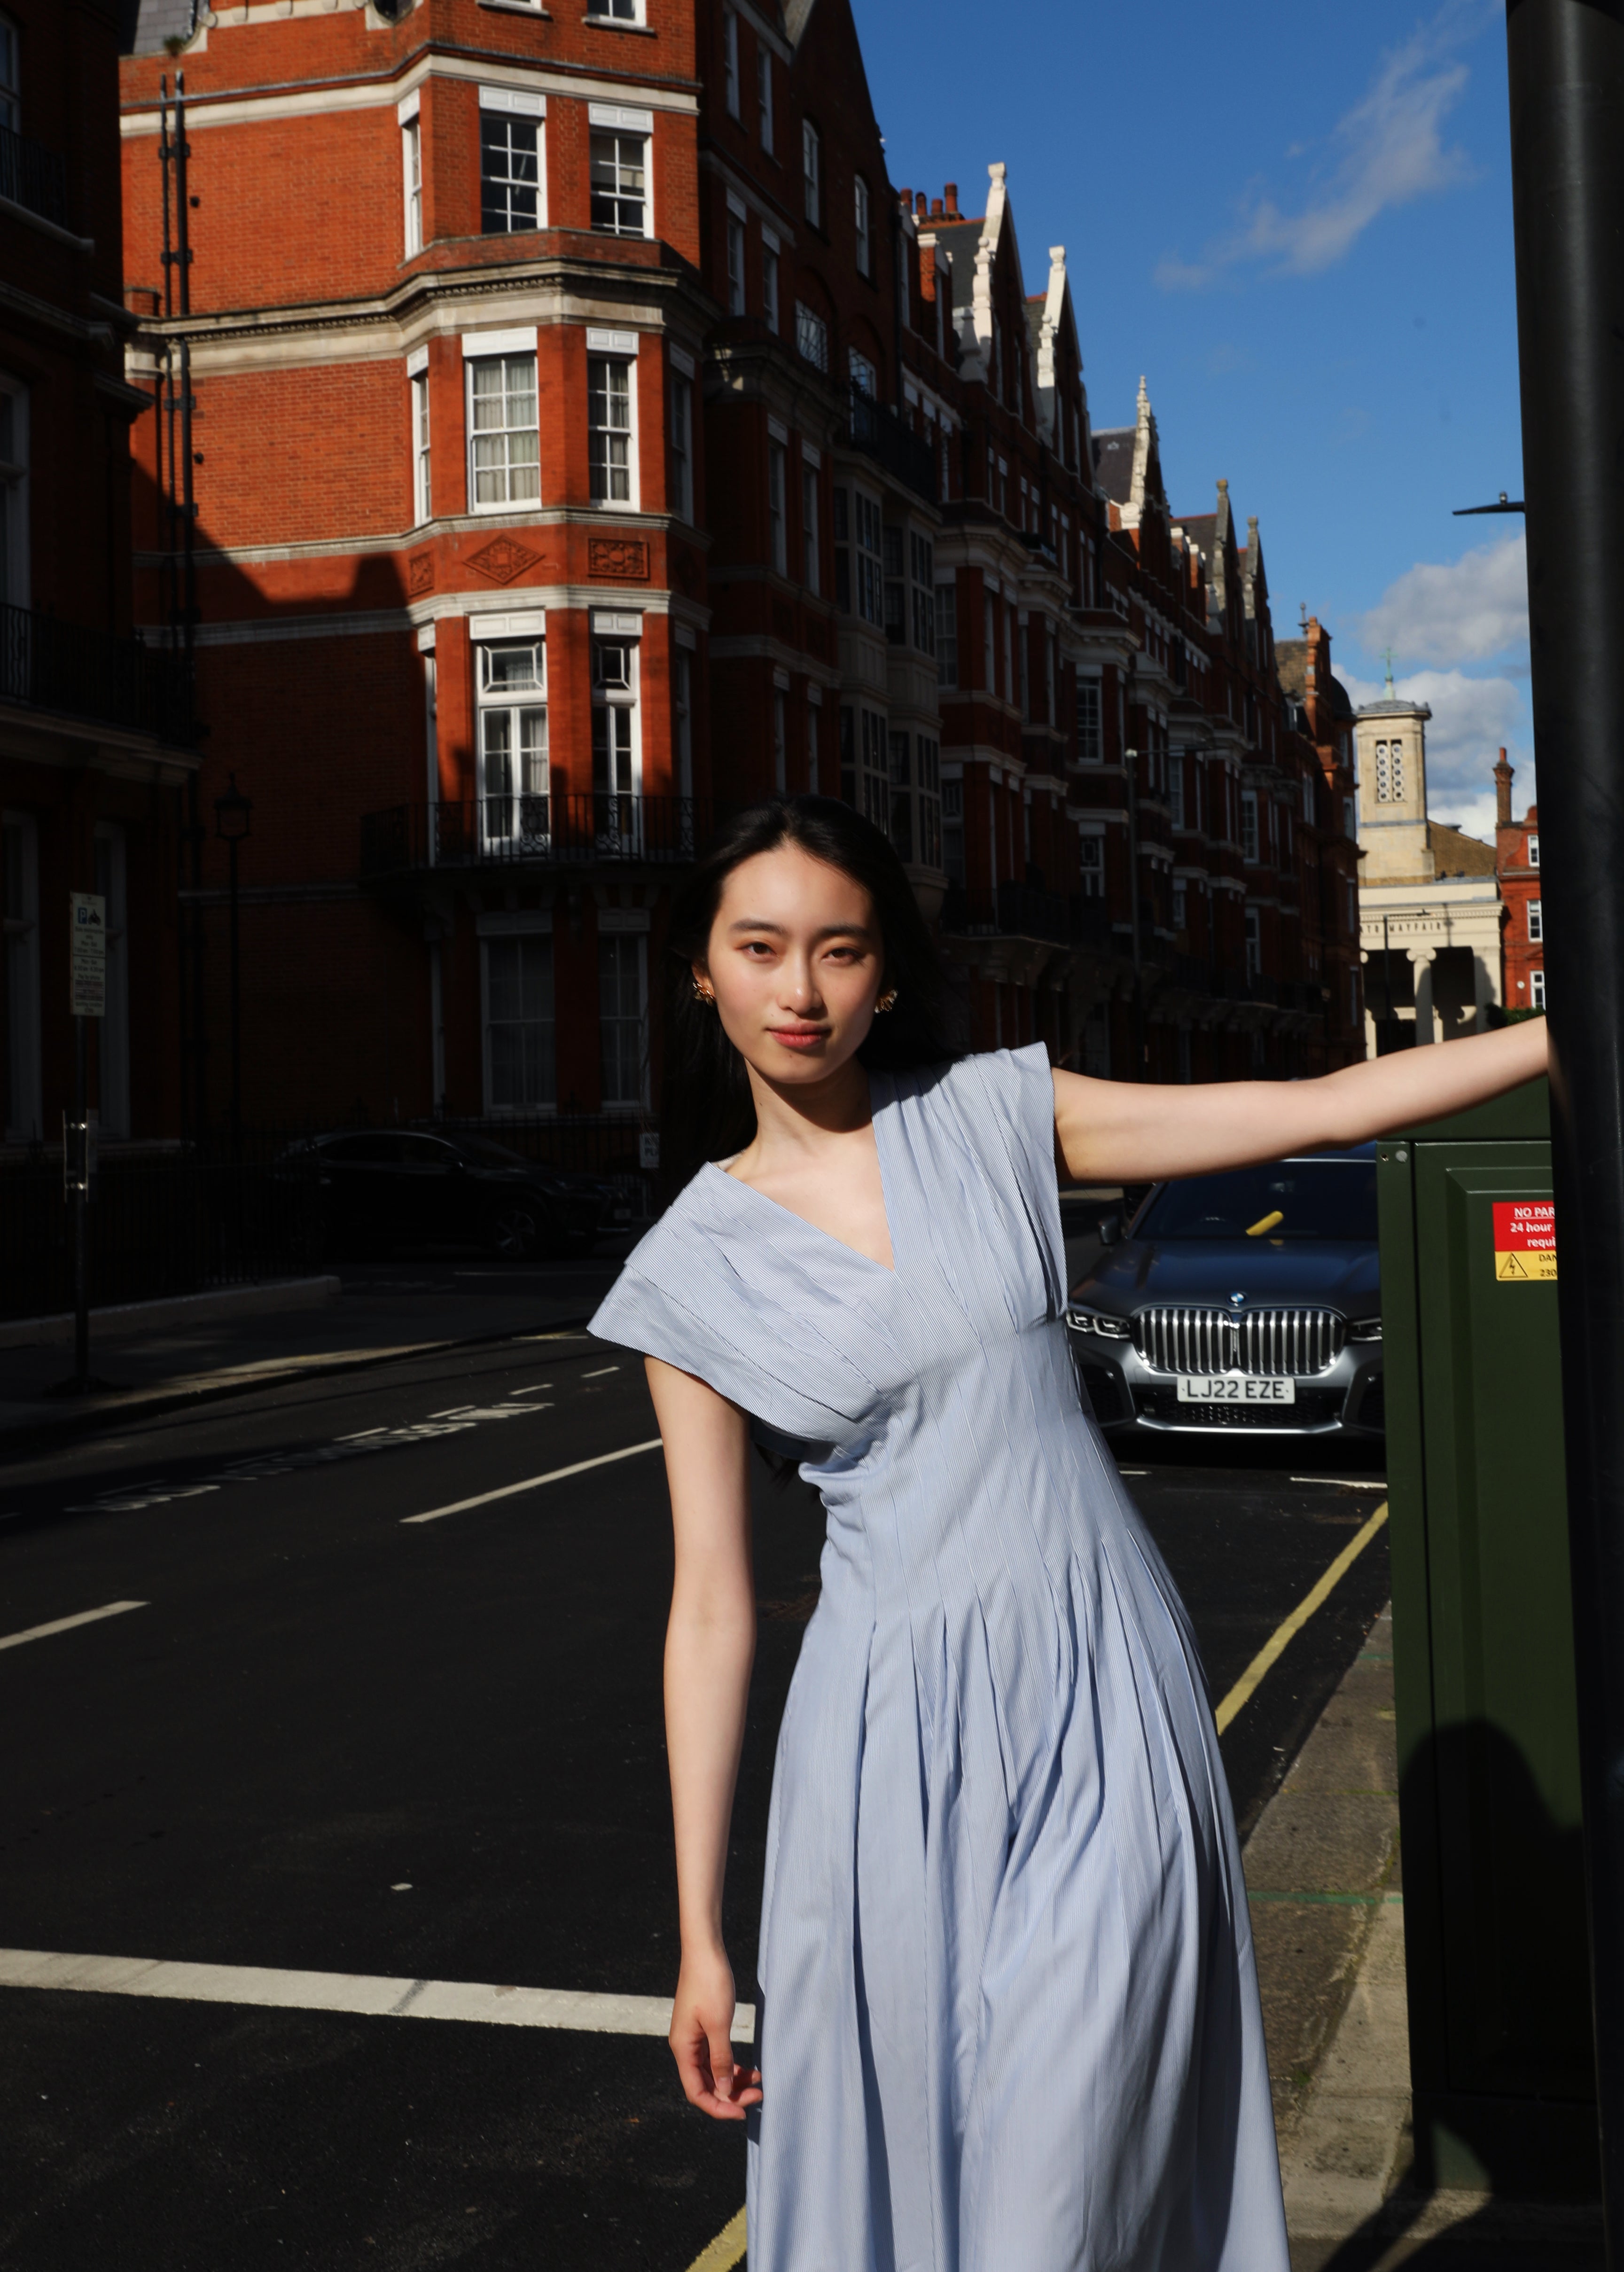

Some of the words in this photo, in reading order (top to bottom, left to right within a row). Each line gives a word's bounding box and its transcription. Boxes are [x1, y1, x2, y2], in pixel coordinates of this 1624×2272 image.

[1390, 922, 1441, 932] MAYFAIR
[1514, 1207, 1532, 1217] NO
[1510, 1222, 1524, 1233] 24
[1526, 1221, 1552, 1233] hour
[1187, 1379, 1239, 1398] LJ22
[1245, 1381, 1285, 1399] EZE
